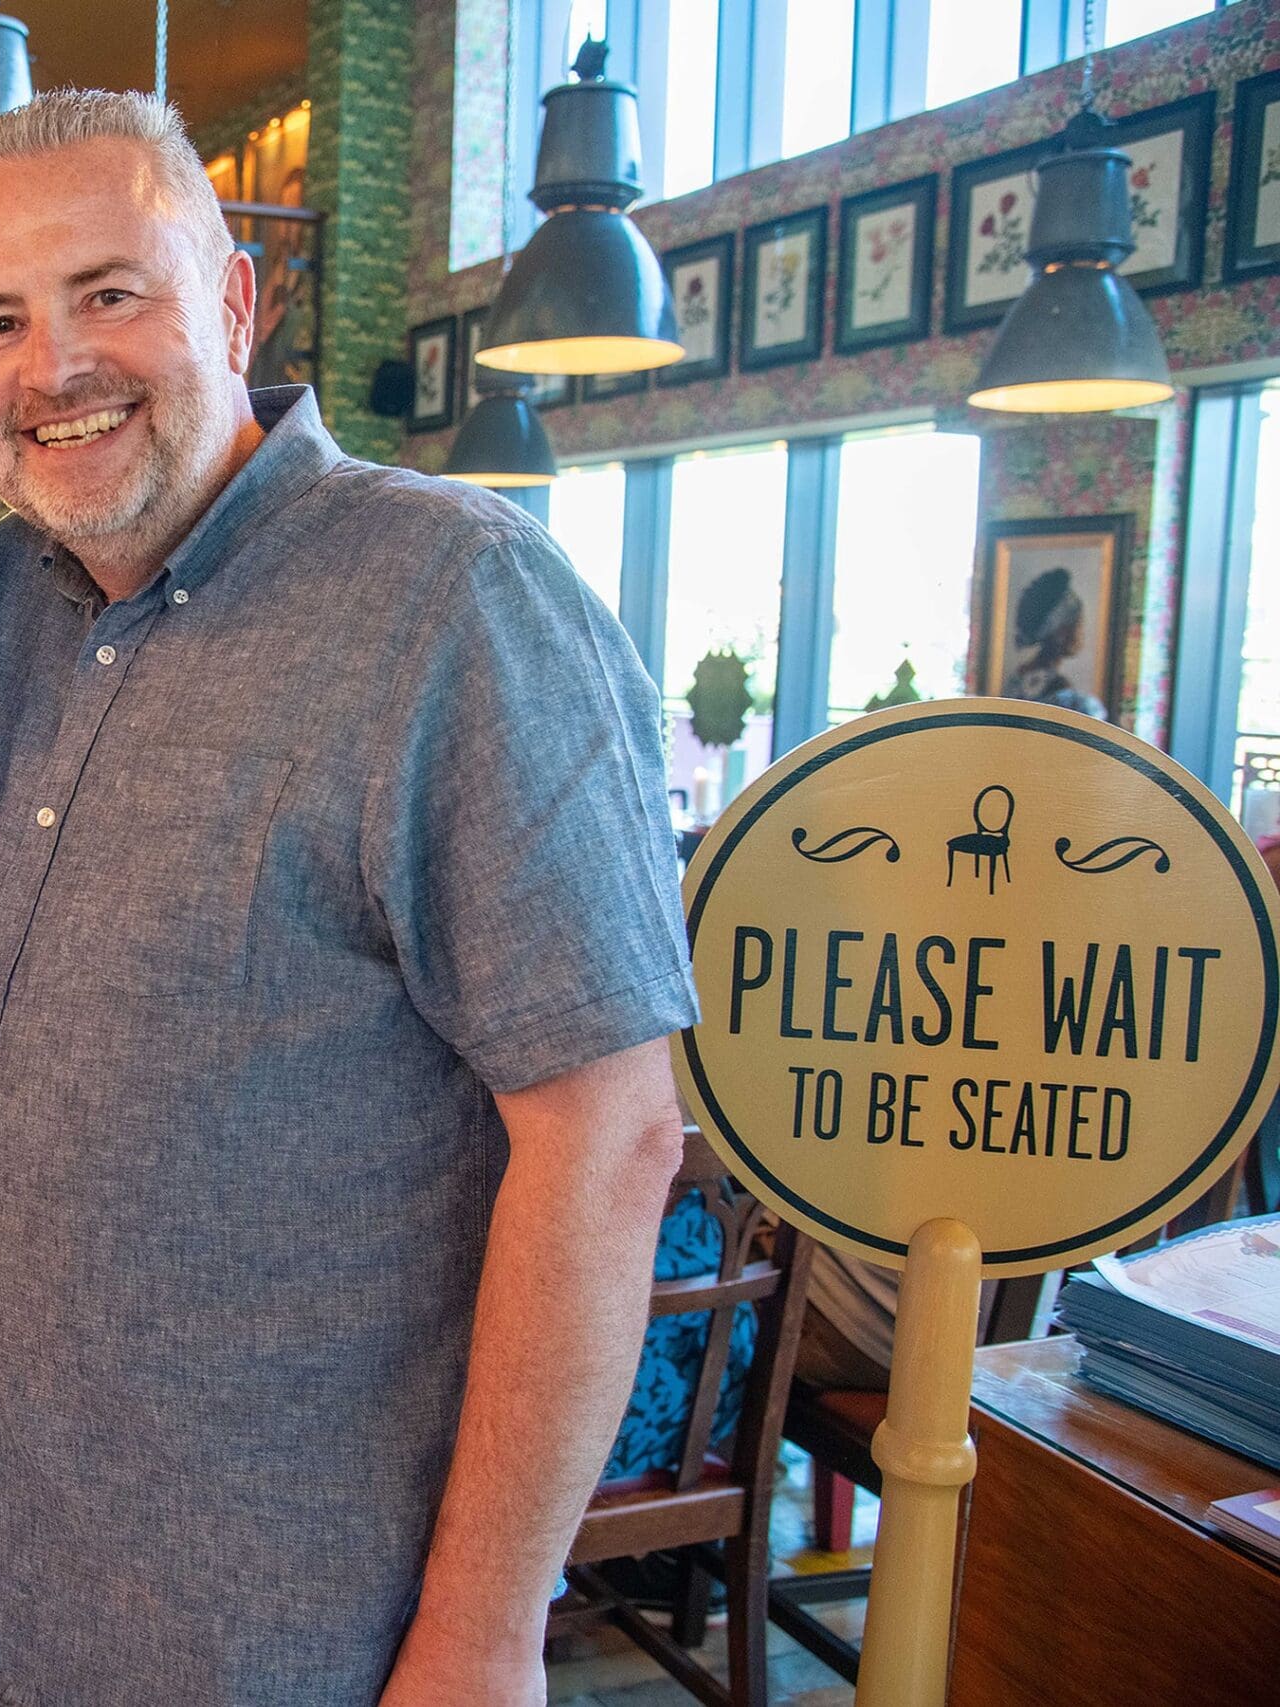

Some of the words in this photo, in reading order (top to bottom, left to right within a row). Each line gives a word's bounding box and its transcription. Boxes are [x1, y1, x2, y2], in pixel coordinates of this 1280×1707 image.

[729, 925, 1006, 1051] PLEASE
[1041, 940, 1222, 1063] WAIT
[788, 1066, 843, 1141] TO
[866, 1071, 929, 1148] BE
[948, 1077, 1132, 1162] SEATED
